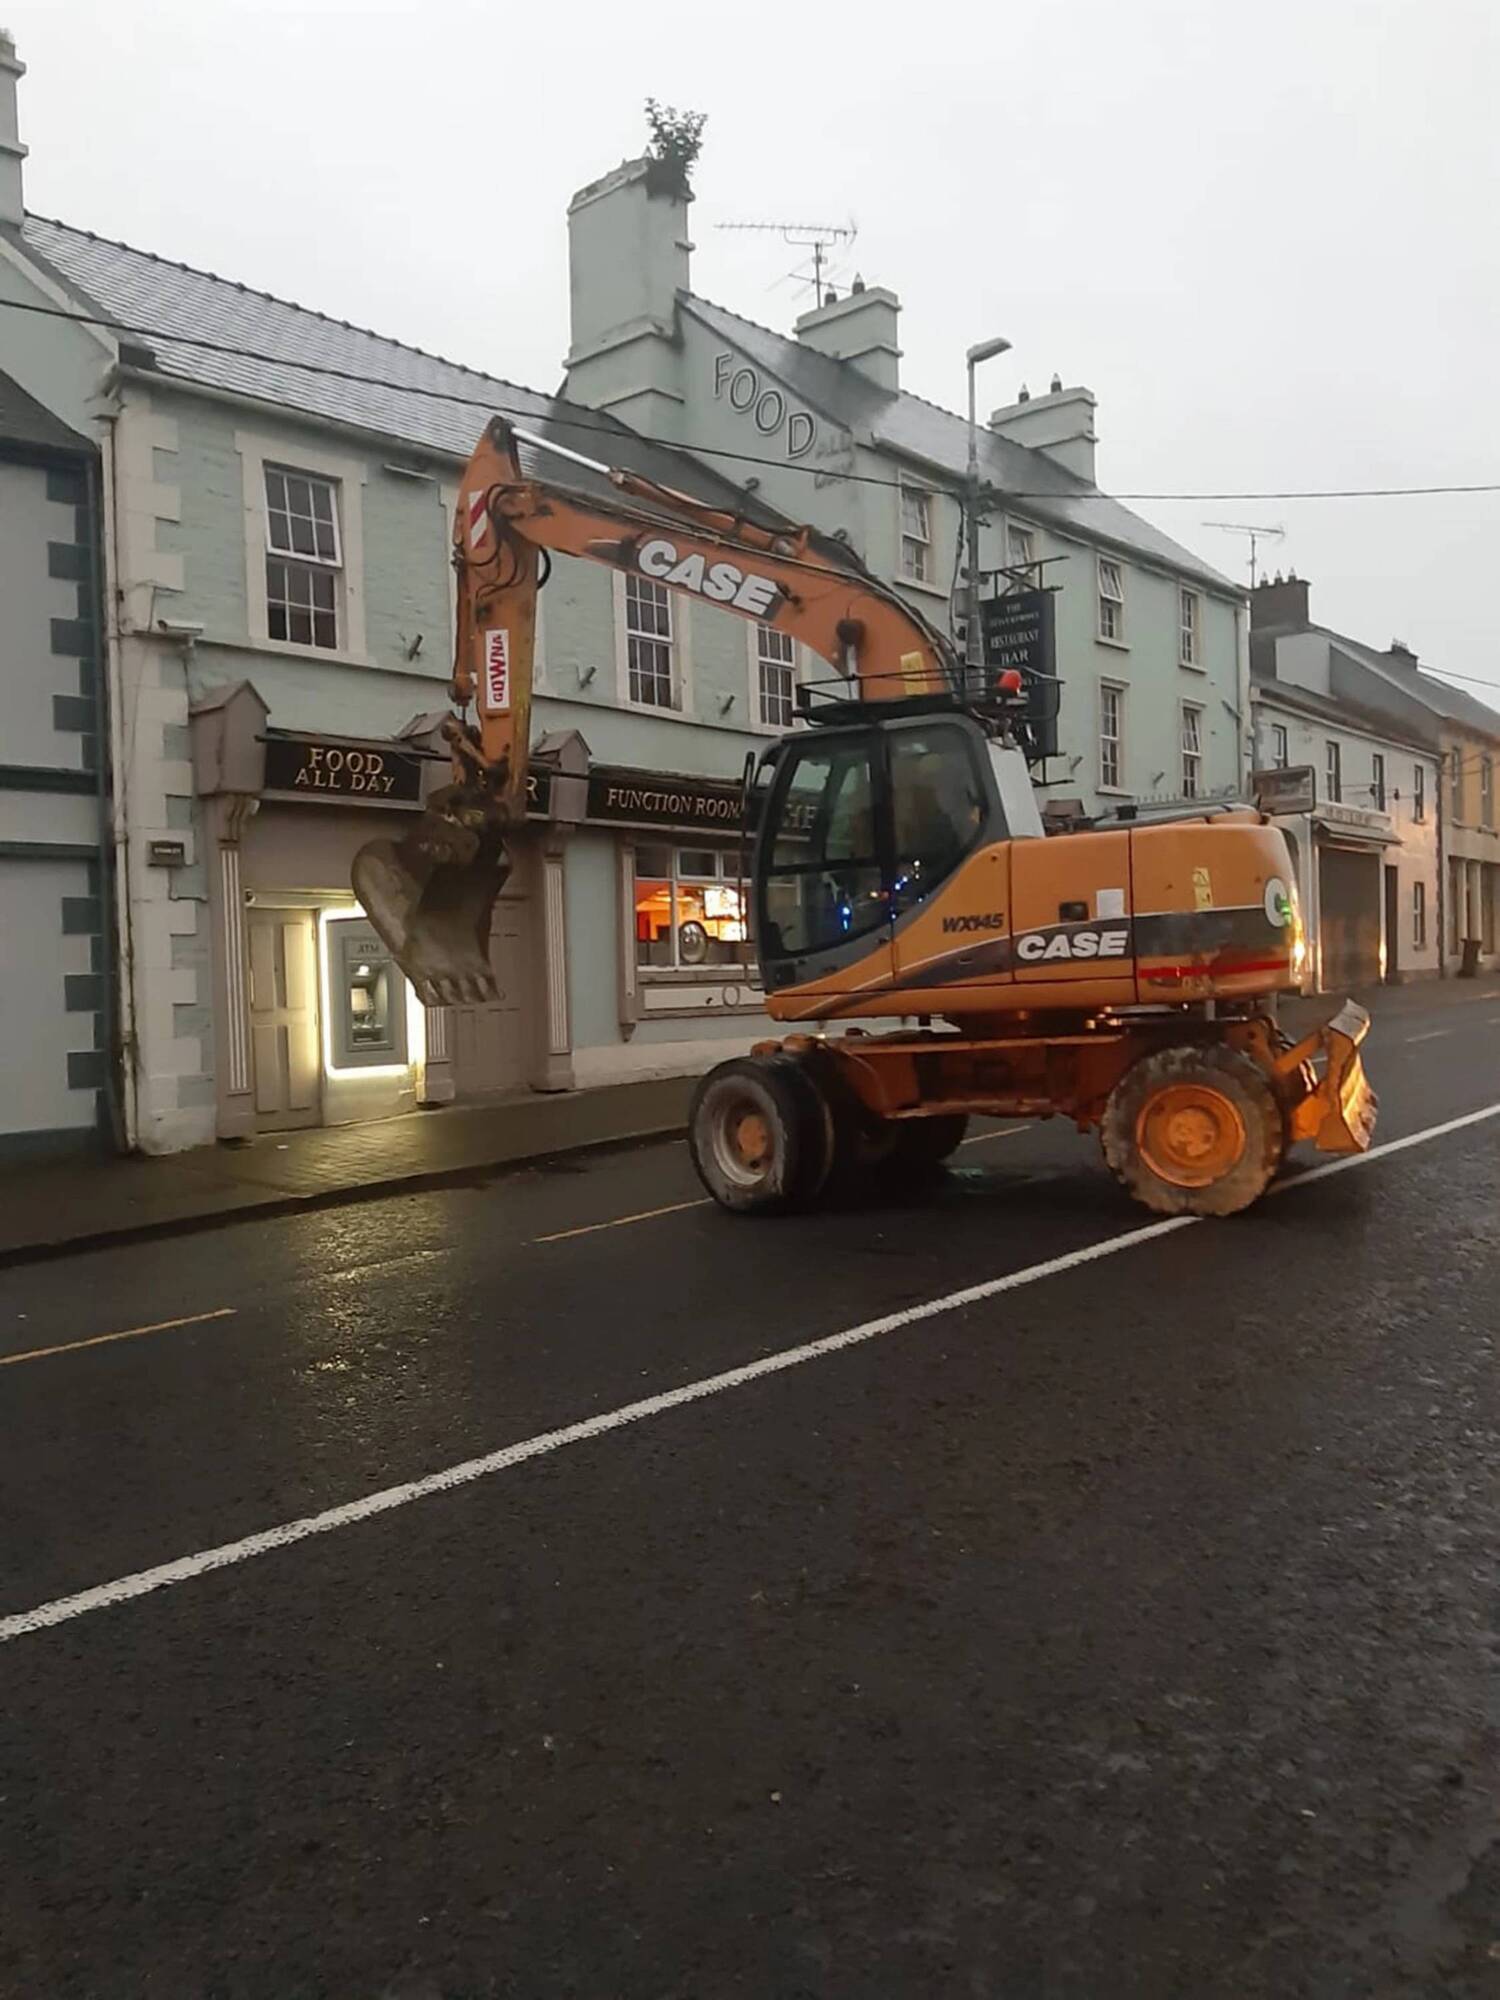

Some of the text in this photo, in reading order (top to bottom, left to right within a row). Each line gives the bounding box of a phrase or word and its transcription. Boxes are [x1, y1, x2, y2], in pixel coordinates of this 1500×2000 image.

[714, 353, 815, 459] FOOD
[638, 539, 778, 615] CASE
[1001, 649, 1029, 666] BAR
[308, 748, 384, 775] FOOD
[294, 768, 395, 793] ALL DAY
[607, 788, 692, 814] FUNCTION
[1017, 931, 1128, 960] CASE
